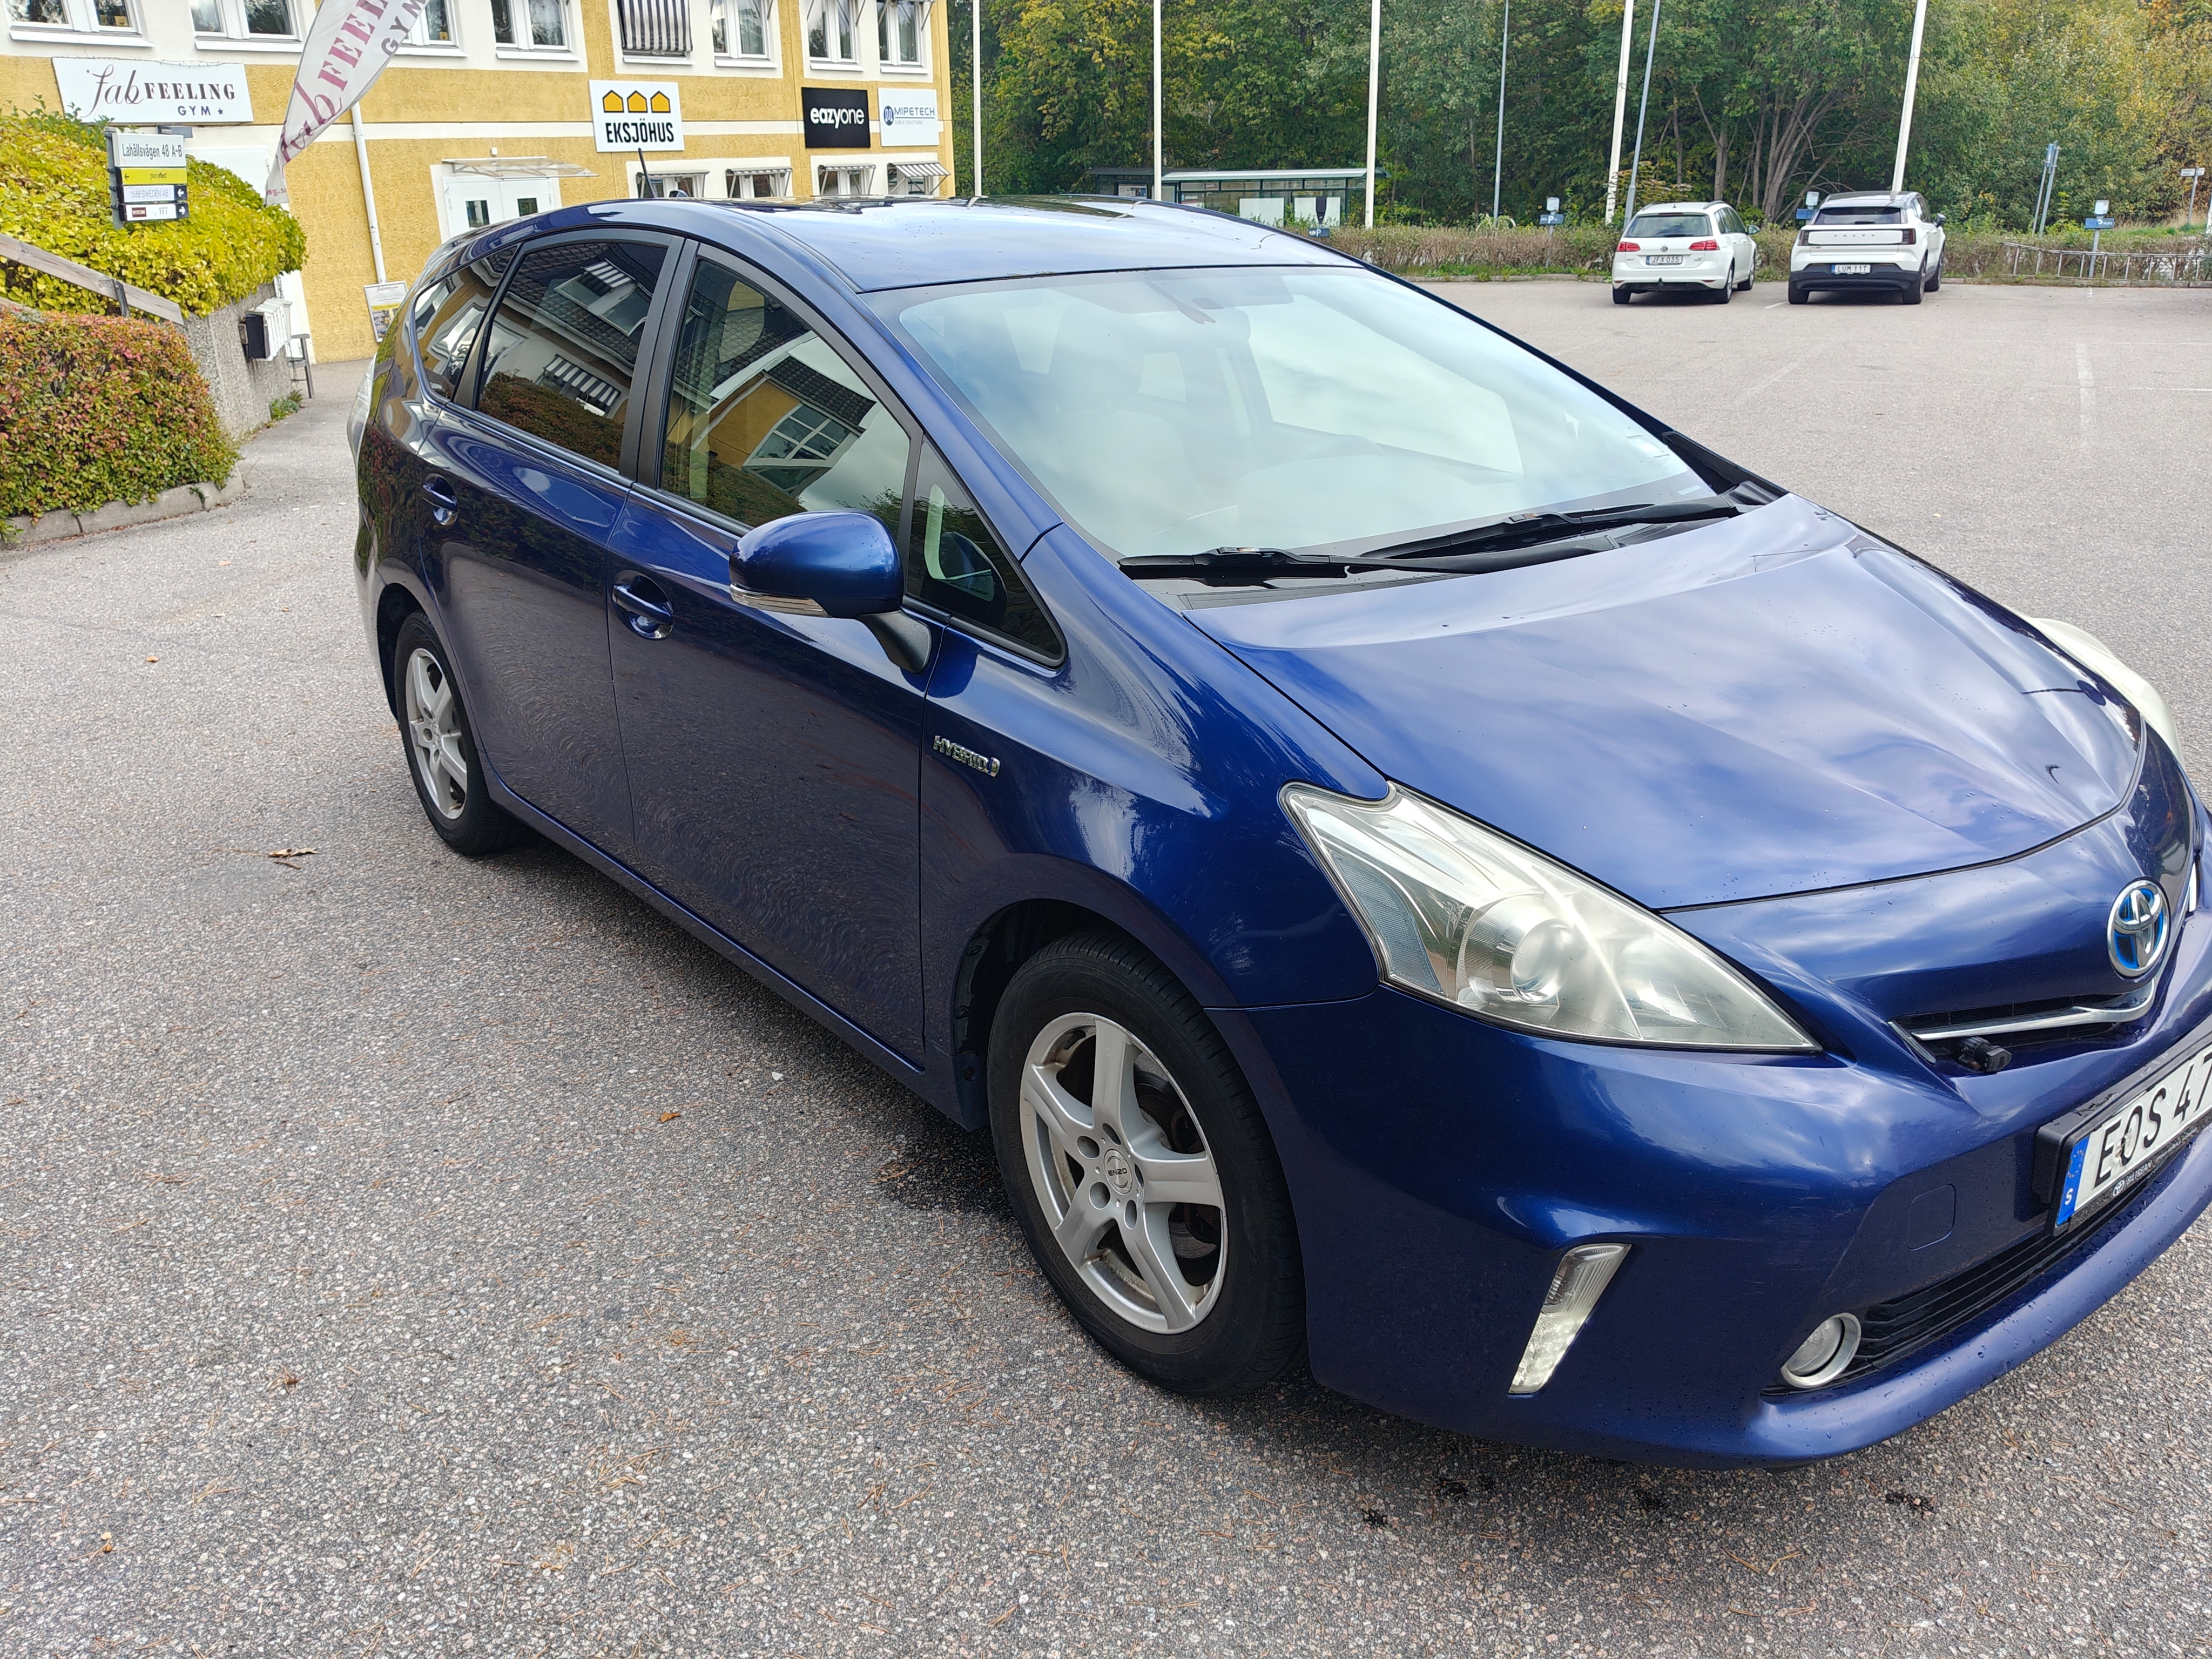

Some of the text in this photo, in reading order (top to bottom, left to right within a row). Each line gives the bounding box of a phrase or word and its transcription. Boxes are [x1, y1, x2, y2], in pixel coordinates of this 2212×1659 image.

[381, 0, 427, 56] GYM
[143, 82, 235, 100] FEELING
[177, 105, 211, 116] GYM
[810, 107, 865, 129] eazyone
[894, 106, 935, 116] MIPETECH
[605, 118, 674, 143] EKSJÖHUS
[122, 143, 183, 160] Lahällsvägen 48 A-B
[933, 735, 989, 772] HYBRID
[2093, 1087, 2167, 1189] EOS
[2065, 1188, 2073, 1205] S
